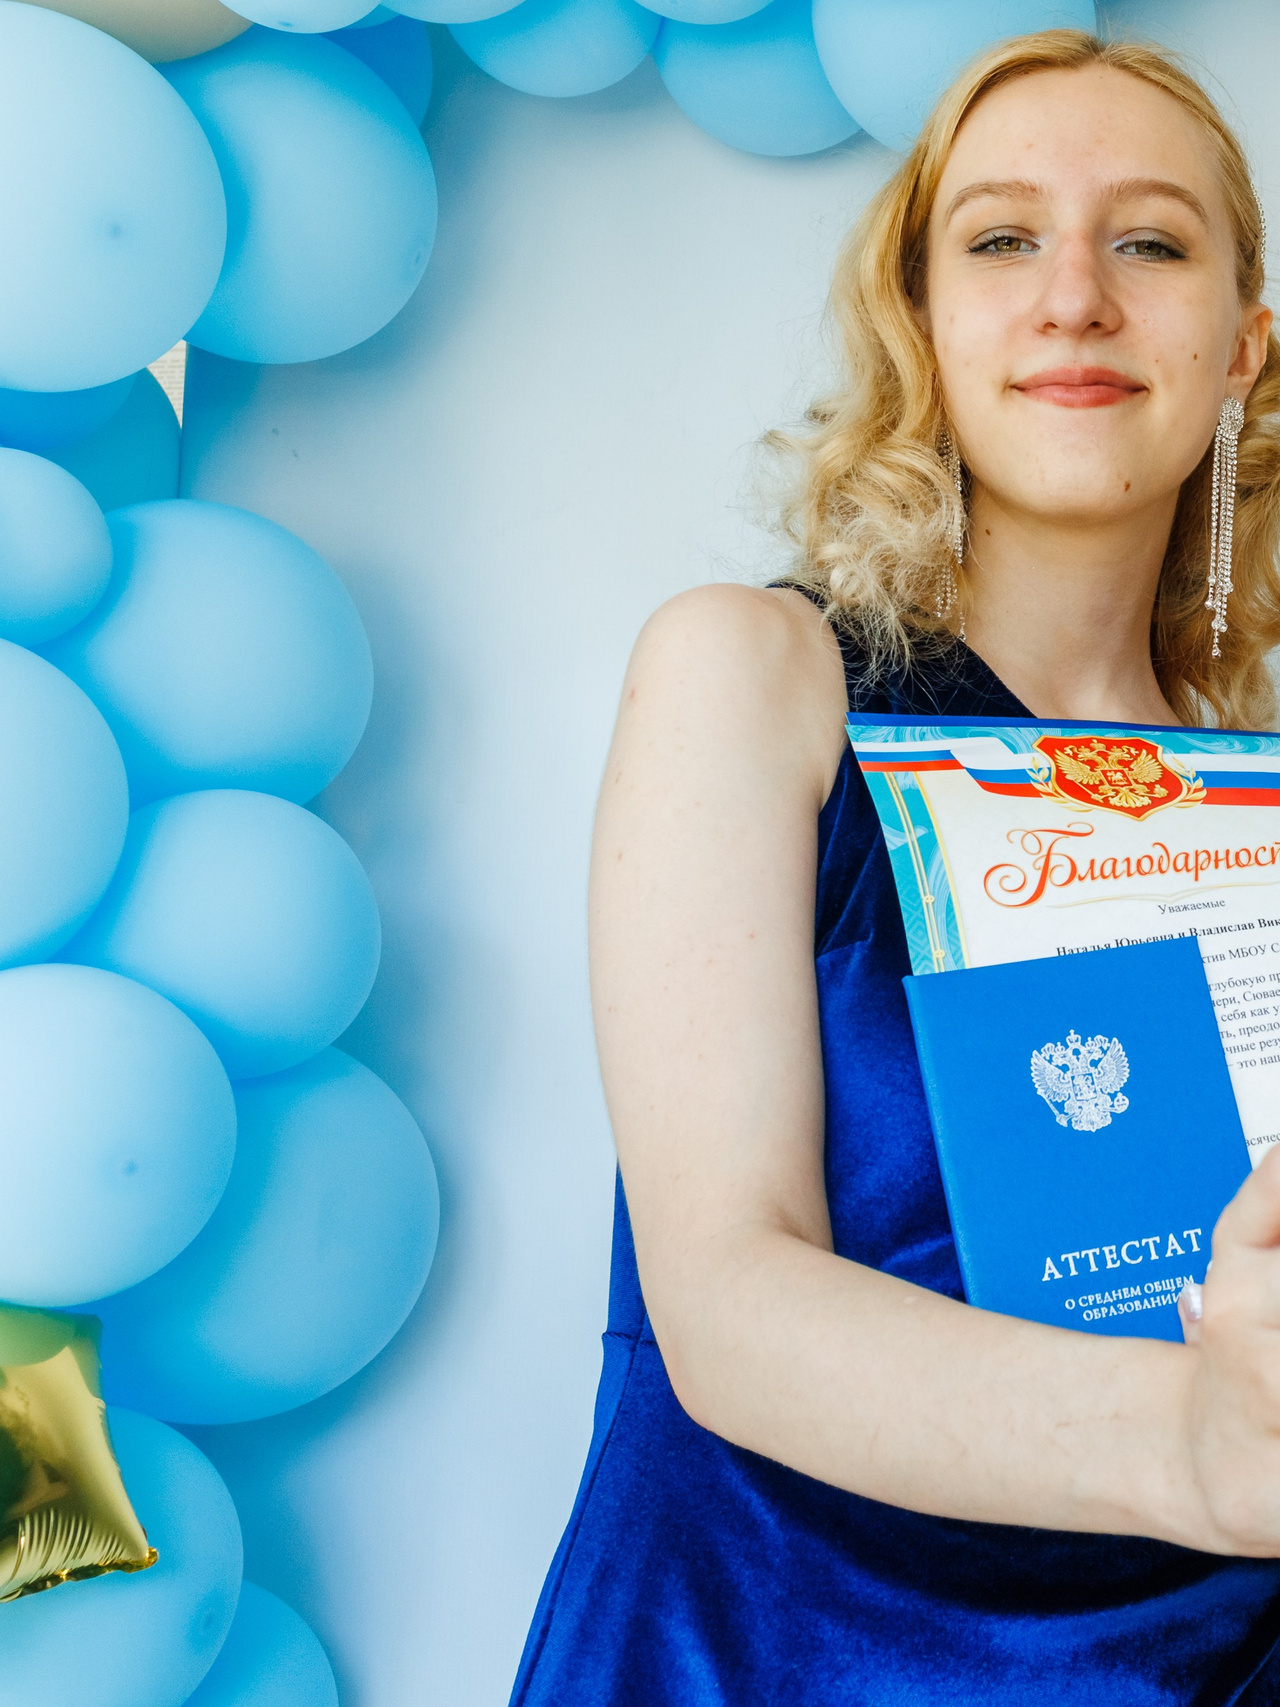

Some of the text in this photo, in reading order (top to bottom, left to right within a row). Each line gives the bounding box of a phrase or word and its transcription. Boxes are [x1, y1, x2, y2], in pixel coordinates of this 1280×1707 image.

[1157, 899, 1226, 914] Уважаемые
[1056, 943, 1112, 956] Наталья
[1189, 920, 1255, 937] Владислав
[1228, 944, 1267, 960] МБОУ
[1208, 975, 1266, 992] глубокую
[1220, 1009, 1247, 1022] себя
[1250, 1007, 1270, 1018] как
[1236, 1059, 1257, 1069] это
[1041, 1228, 1202, 1282] АТТЕСТАТ
[1064, 1274, 1195, 1310] О СРЕДНЕМ ОБЩЕМ
